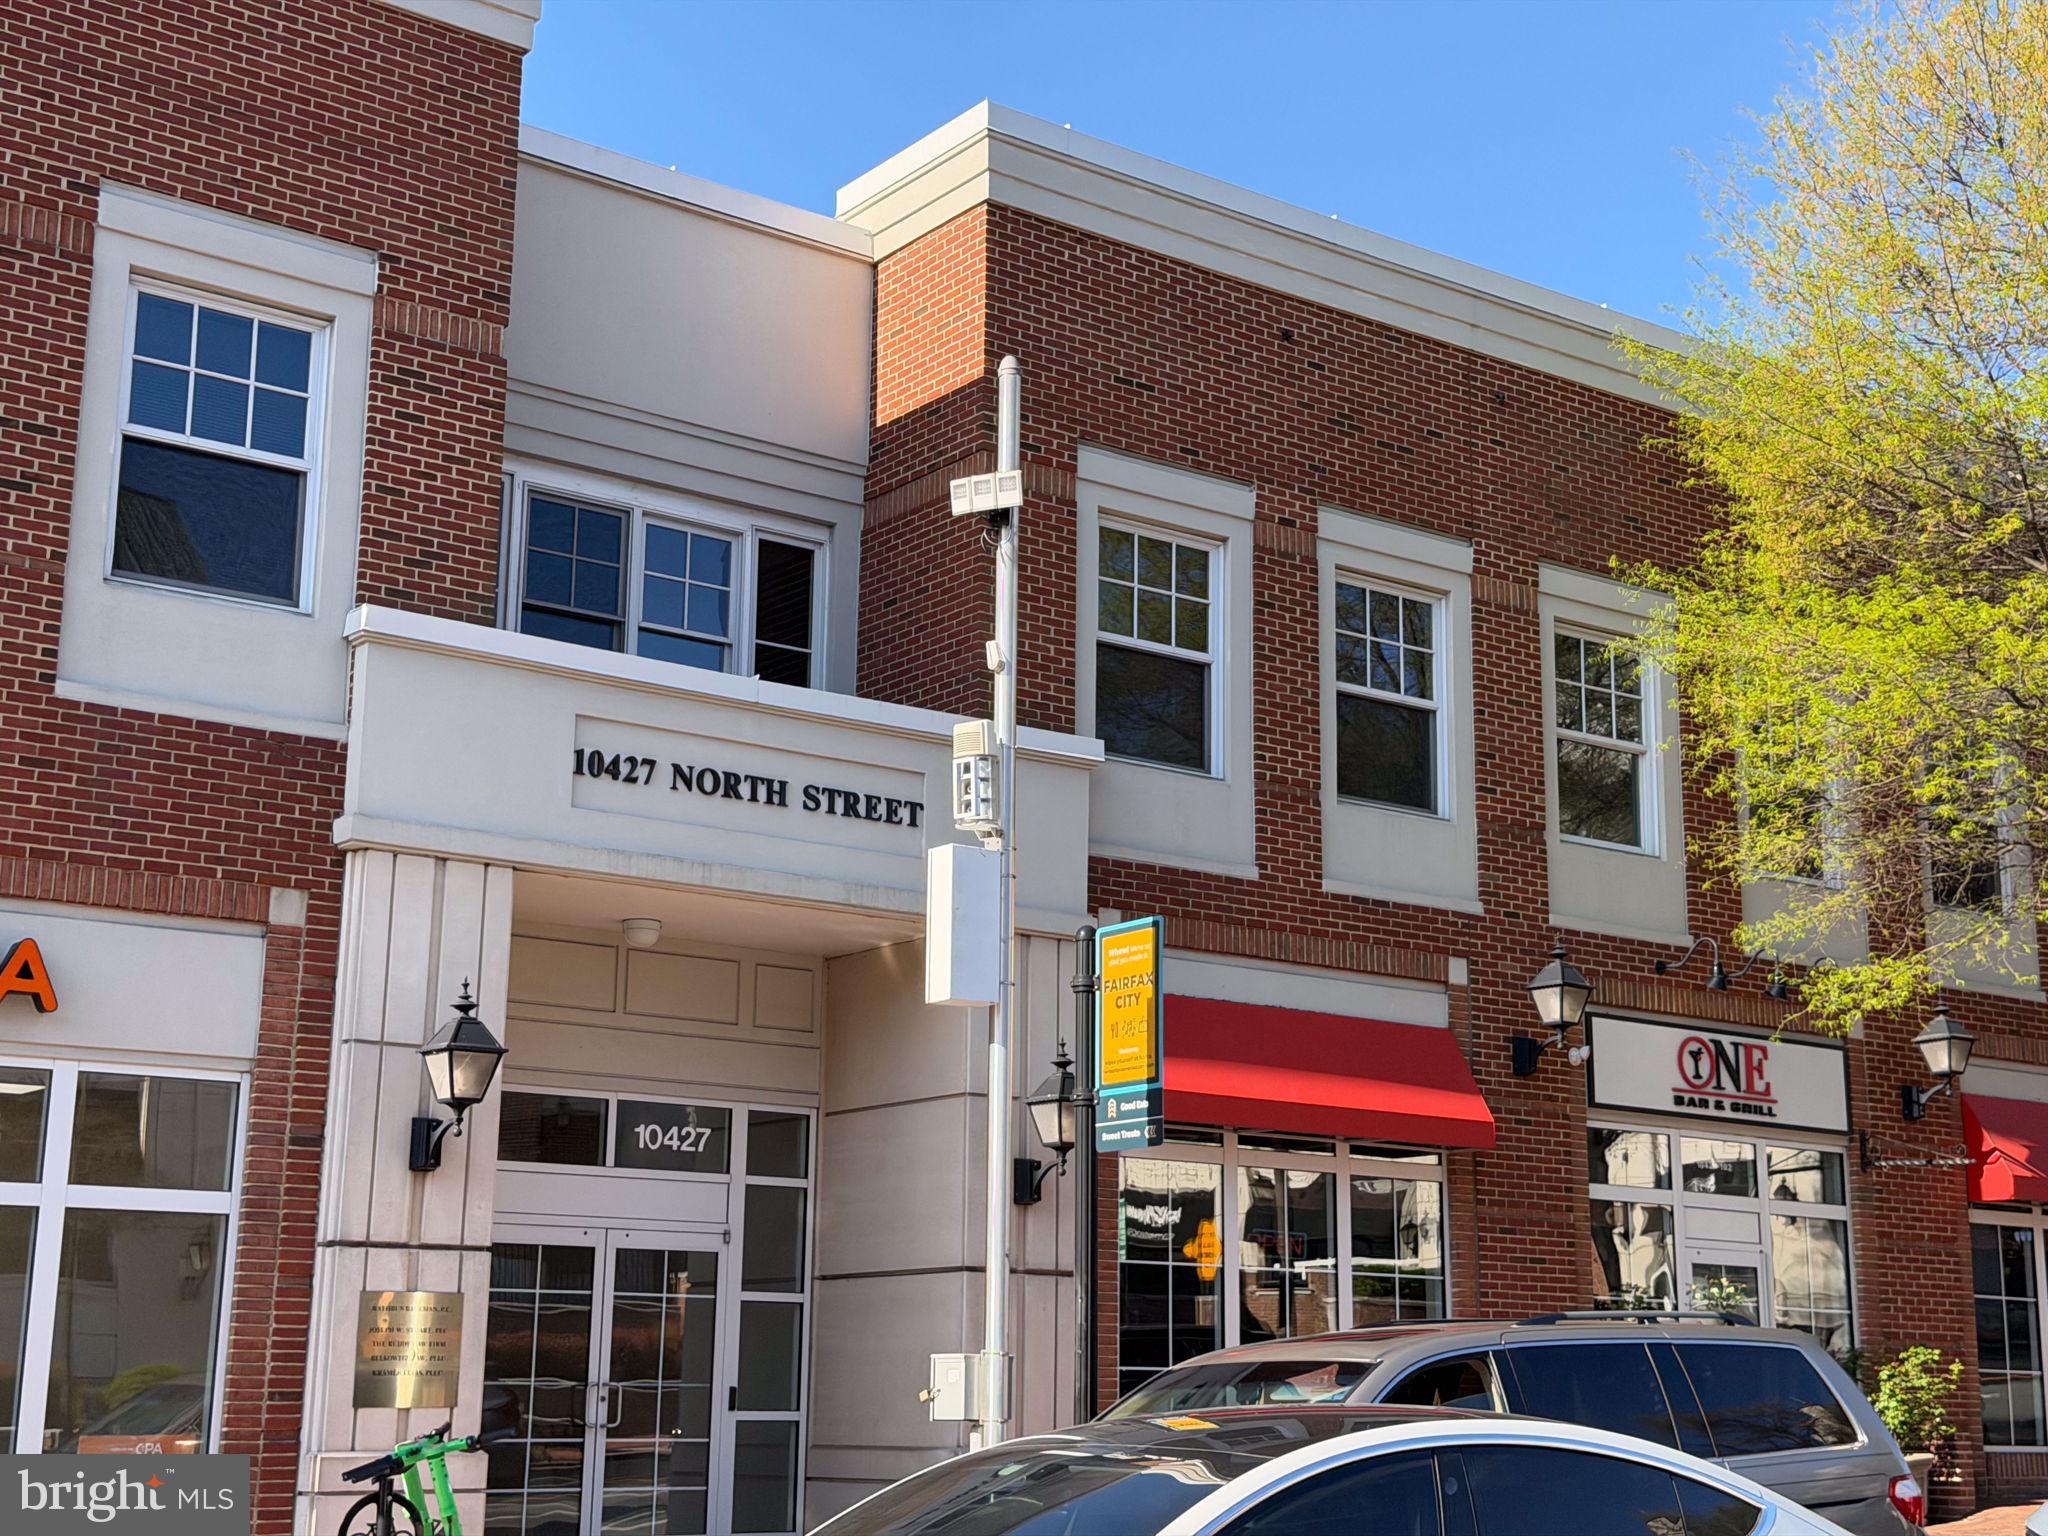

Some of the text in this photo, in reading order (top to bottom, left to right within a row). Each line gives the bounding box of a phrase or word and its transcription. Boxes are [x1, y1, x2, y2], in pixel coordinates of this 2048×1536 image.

[572, 748, 925, 828] 10427 NORTH STREET
[0, 938, 58, 1013] A
[1104, 971, 1154, 994] FAIRFAX
[1115, 992, 1141, 1009] CITY
[1677, 1036, 1771, 1097] ONE
[1120, 1101, 1136, 1111] Good
[1673, 1095, 1777, 1117] BAR & GRILL
[634, 1123, 712, 1152] 10427
[1101, 1129, 1141, 1141] Sweet Treats
